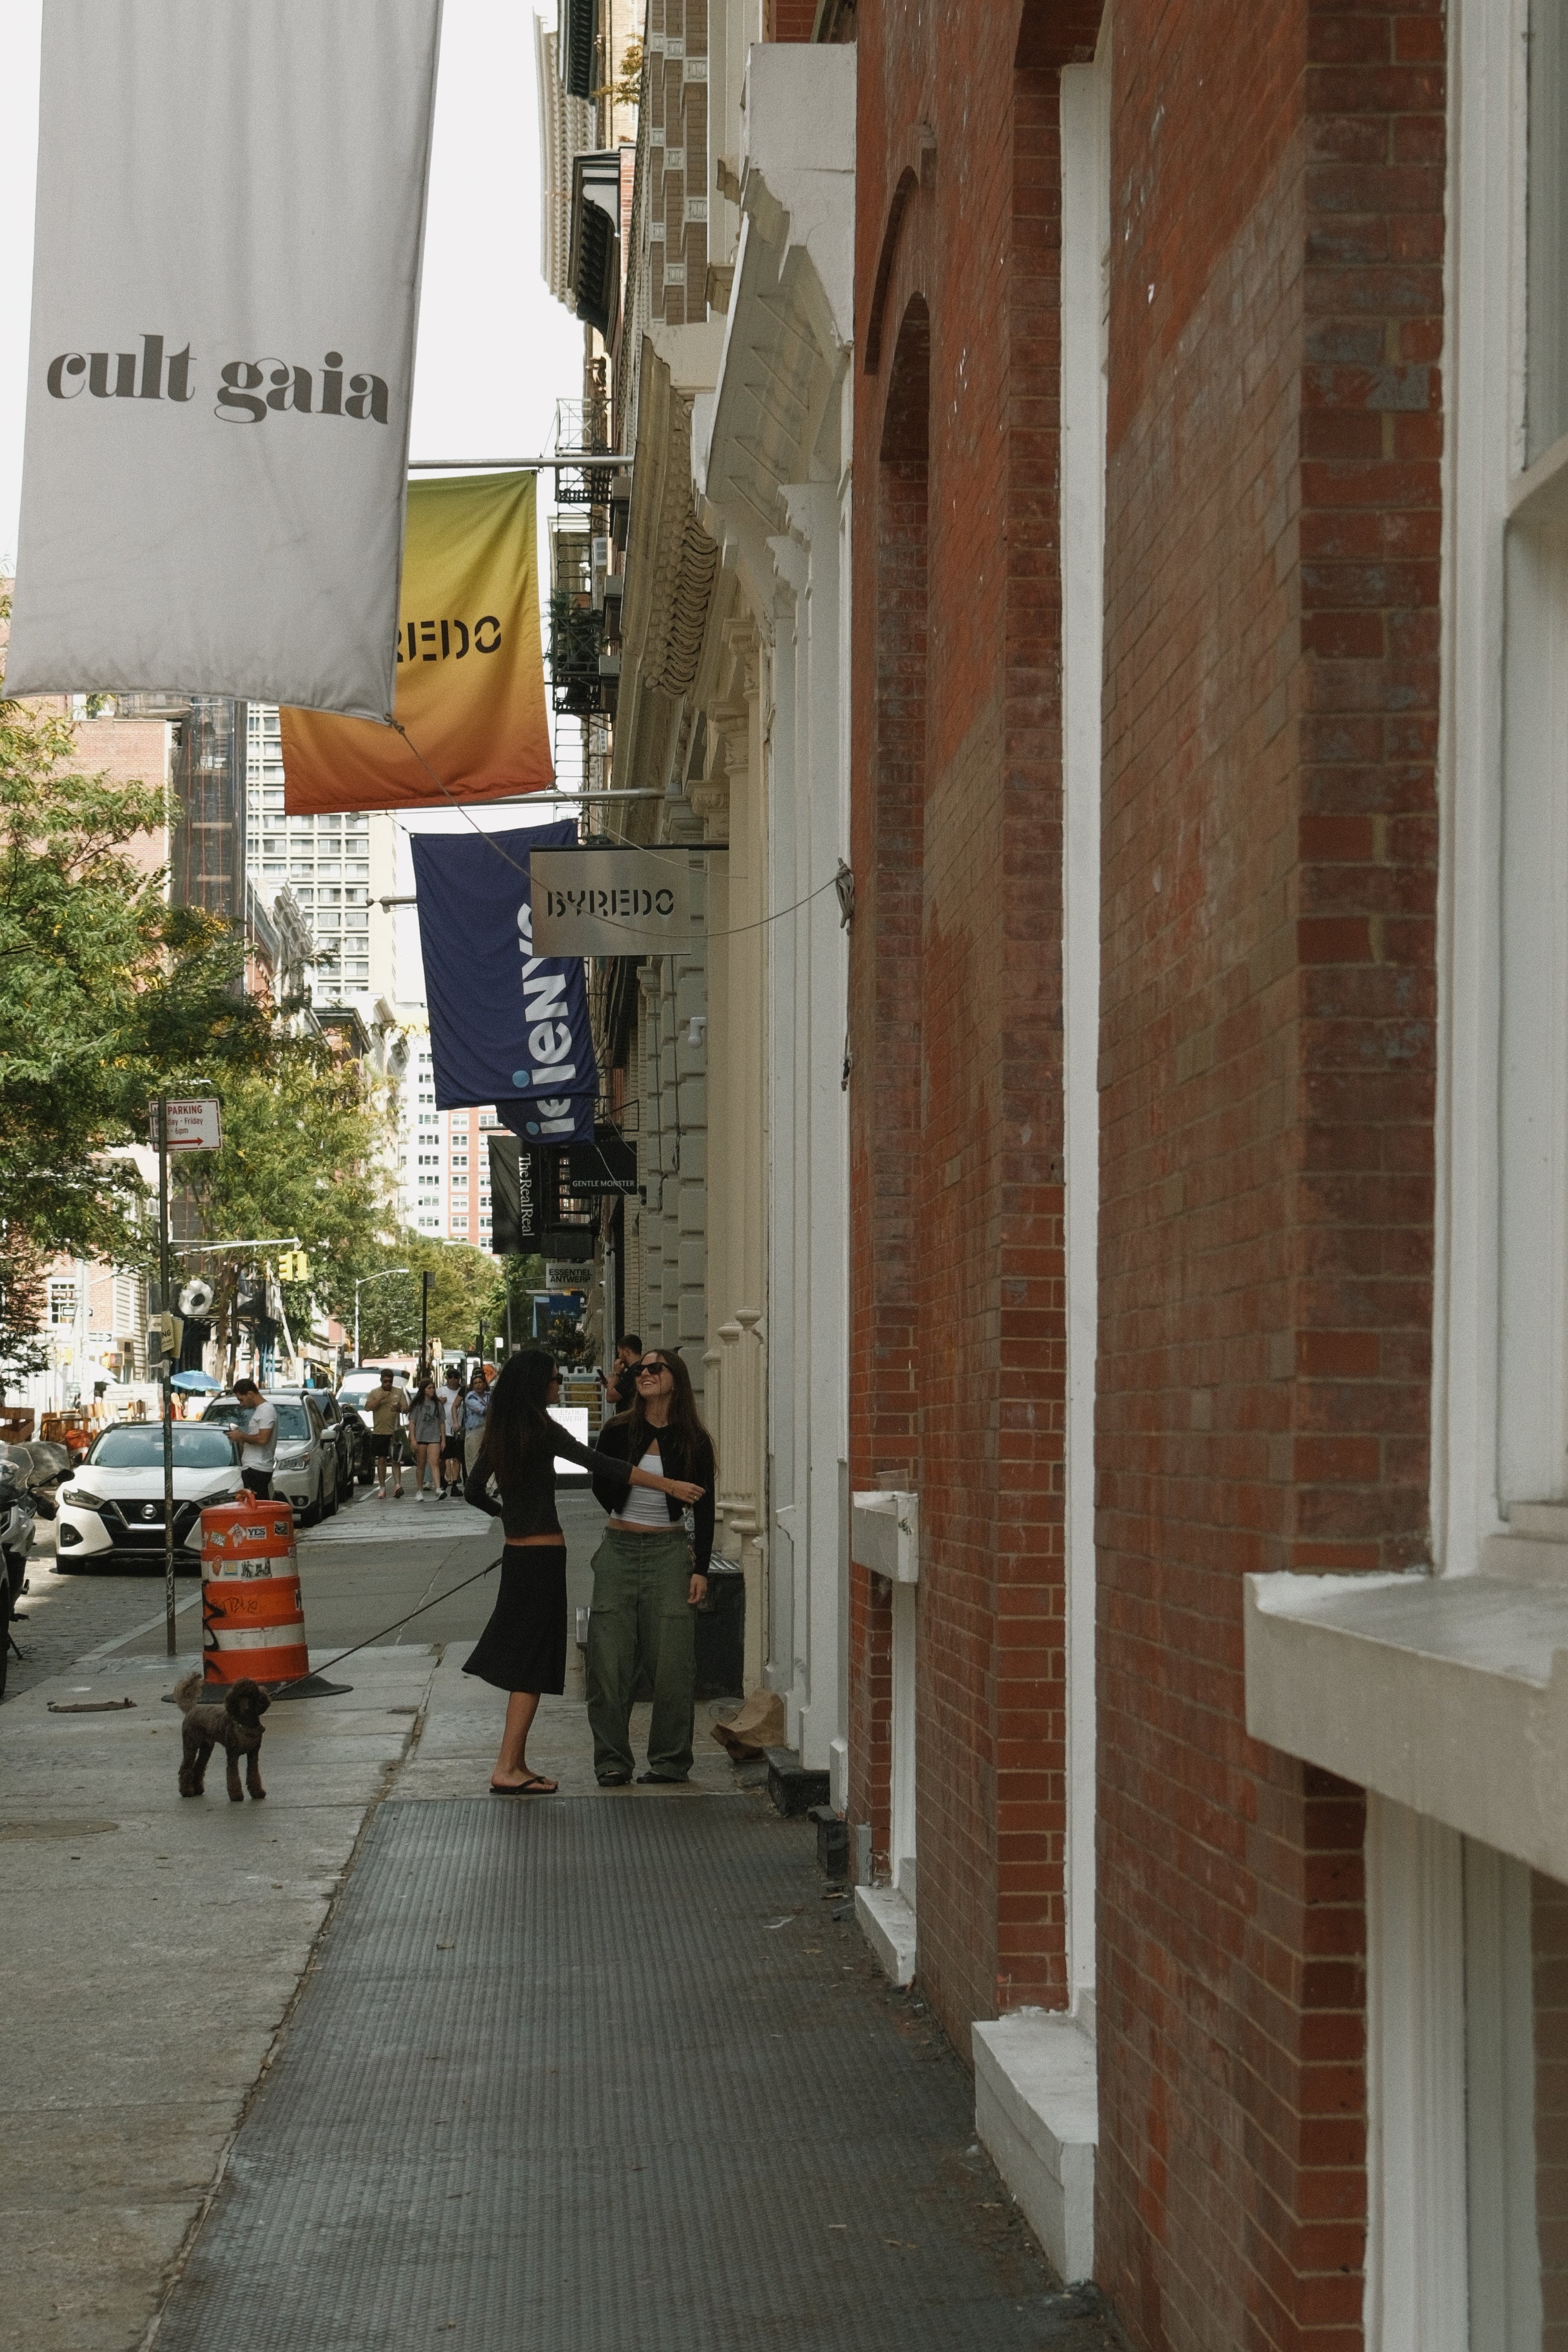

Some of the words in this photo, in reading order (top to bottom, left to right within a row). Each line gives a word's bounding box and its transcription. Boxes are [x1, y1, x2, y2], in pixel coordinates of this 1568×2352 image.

[47, 334, 197, 402] cult
[214, 351, 389, 425] gaia
[547, 889, 674, 918] BYREDO
[168, 1105, 203, 1115] PARKING
[184, 1117, 203, 1126] Friday
[175, 1127, 189, 1135] 6pm
